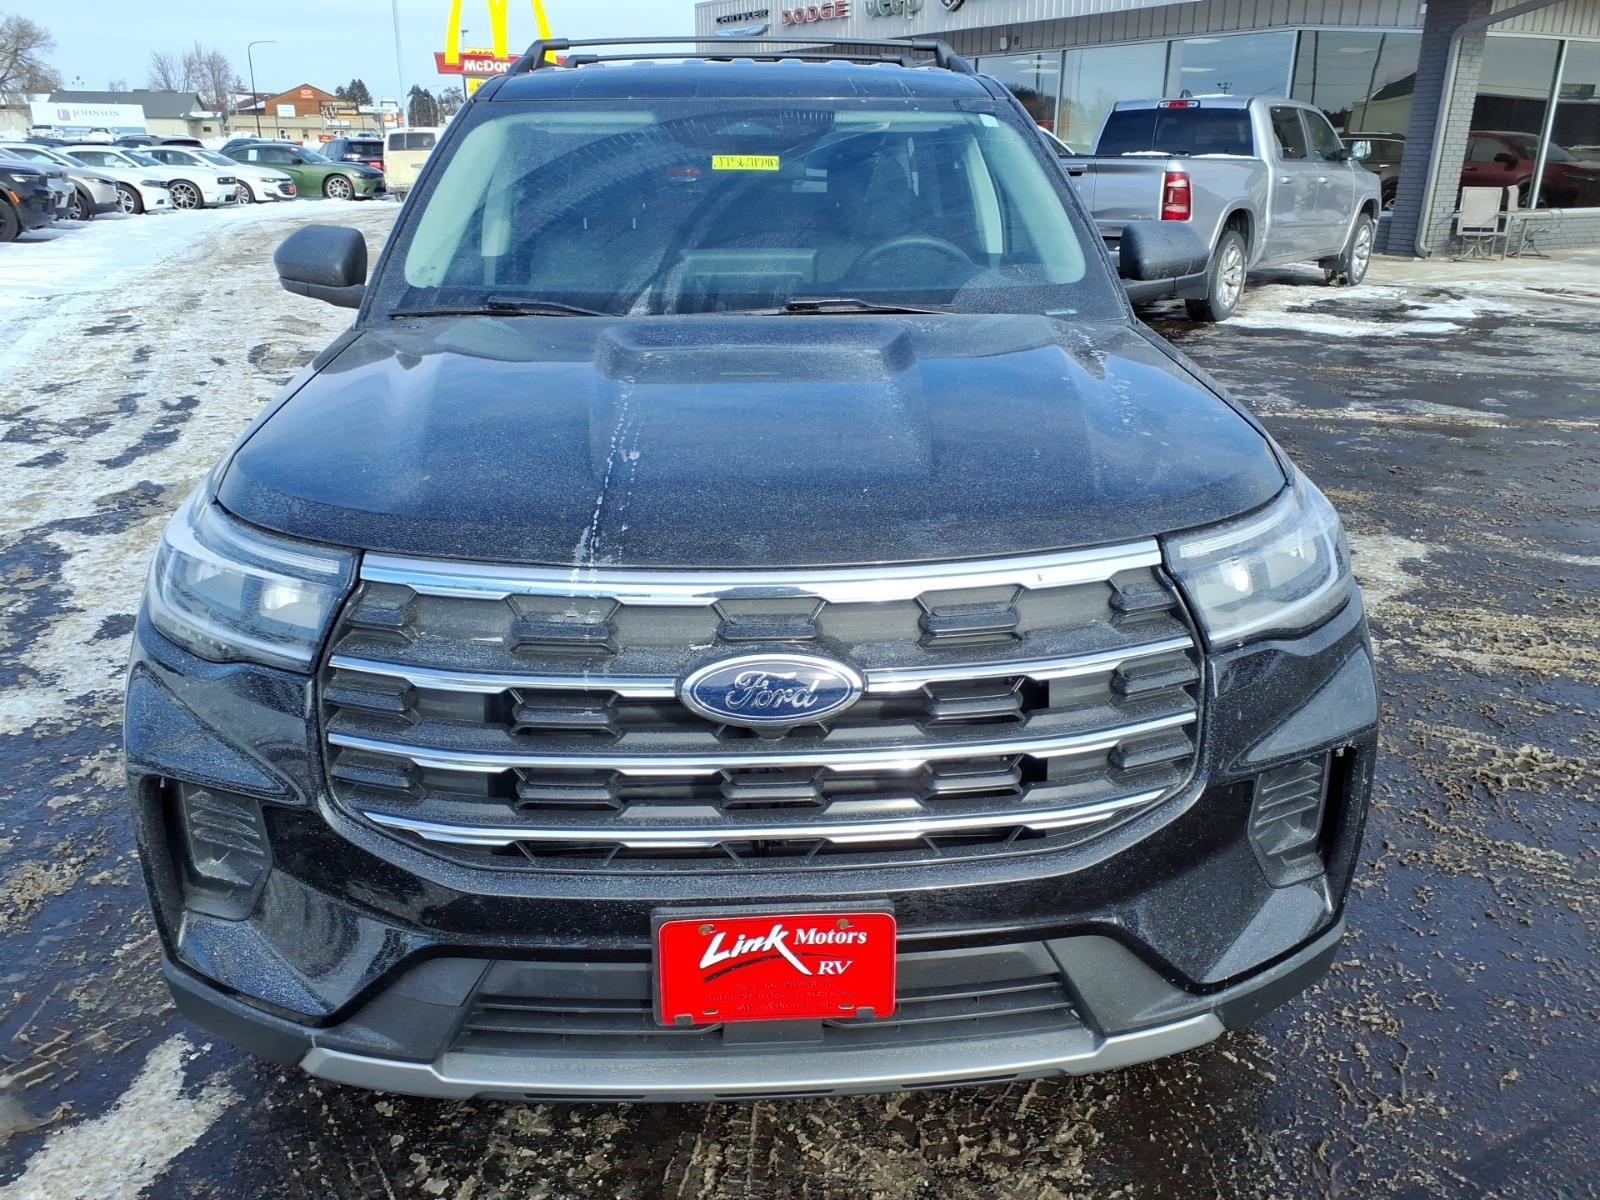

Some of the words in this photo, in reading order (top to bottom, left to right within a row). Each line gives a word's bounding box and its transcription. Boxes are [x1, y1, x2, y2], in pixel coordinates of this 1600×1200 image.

[781, 1, 850, 26] DODGE
[865, 0, 922, 20] Jeep
[73, 109, 120, 118] JOHNSON
[725, 670, 820, 709] Ford
[699, 924, 813, 976] Link
[794, 928, 867, 945] Motors
[818, 961, 853, 975] RV
